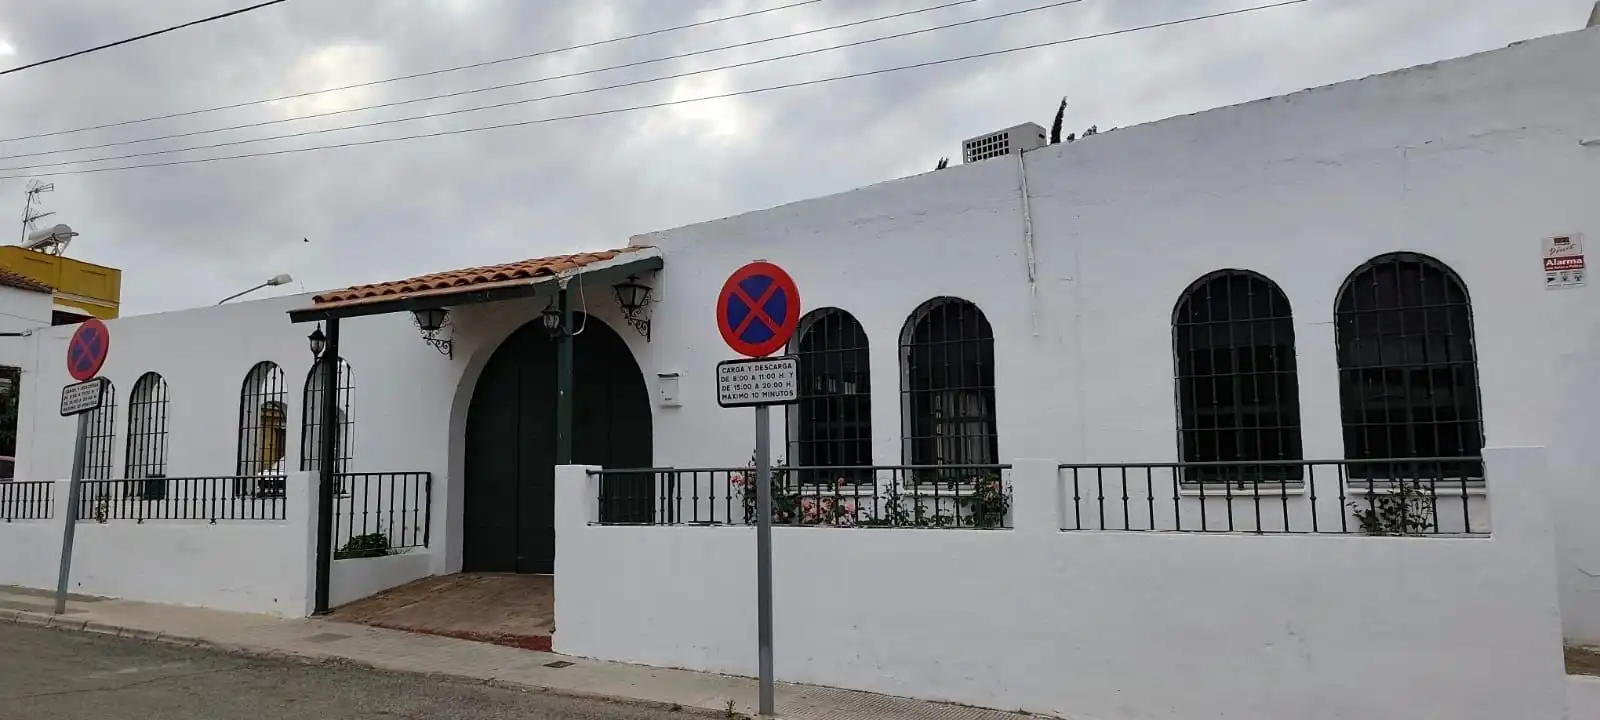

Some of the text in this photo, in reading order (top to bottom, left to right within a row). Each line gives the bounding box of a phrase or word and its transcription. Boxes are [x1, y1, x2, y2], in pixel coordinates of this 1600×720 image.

[1545, 258, 1582, 266] Alarma
[755, 363, 792, 371] DESCARGA
[762, 390, 794, 398] MINUTOS
